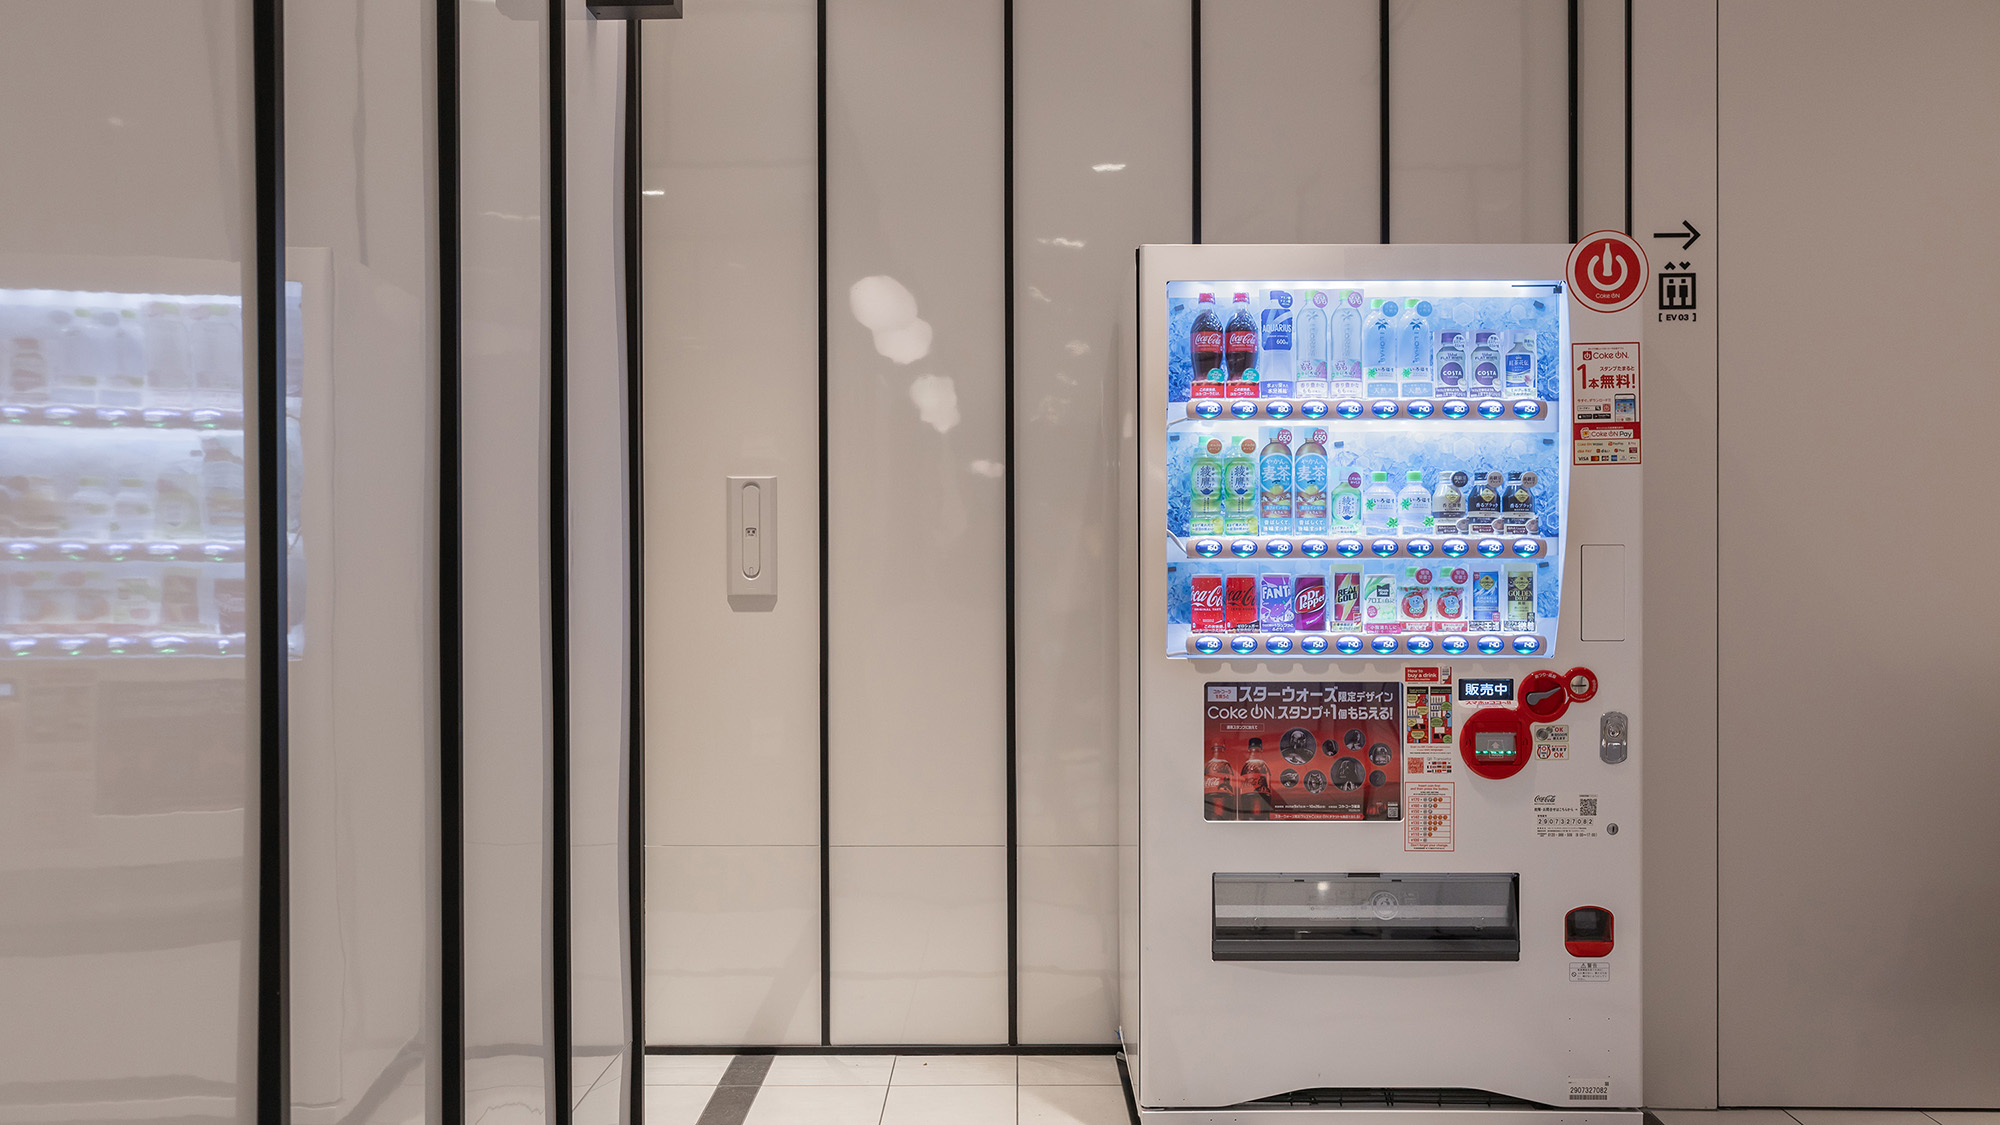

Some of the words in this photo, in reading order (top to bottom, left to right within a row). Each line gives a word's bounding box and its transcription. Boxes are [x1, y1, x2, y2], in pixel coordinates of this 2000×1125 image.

[1262, 324, 1292, 333] AQUARIUS
[1195, 333, 1221, 345] Coca-Cola
[1229, 333, 1256, 345] Coca-Cola
[1577, 364, 1635, 389] 1本無料!
[1200, 465, 1211, 488] 綾鷹
[1234, 465, 1246, 488] 綾鷹
[1262, 465, 1291, 481] 麦茶
[1297, 465, 1326, 481] 麦茶
[1342, 496, 1352, 514] 綾鷹
[1308, 590, 1320, 600] Dr
[1338, 586, 1357, 597] REAL
[1338, 593, 1358, 603] GOLD
[1300, 593, 1325, 610] Pepper
[1239, 686, 1393, 702] スターウォーズ限定デザイン
[1465, 683, 1507, 696] 販売中
[1208, 706, 1248, 719] Coke
